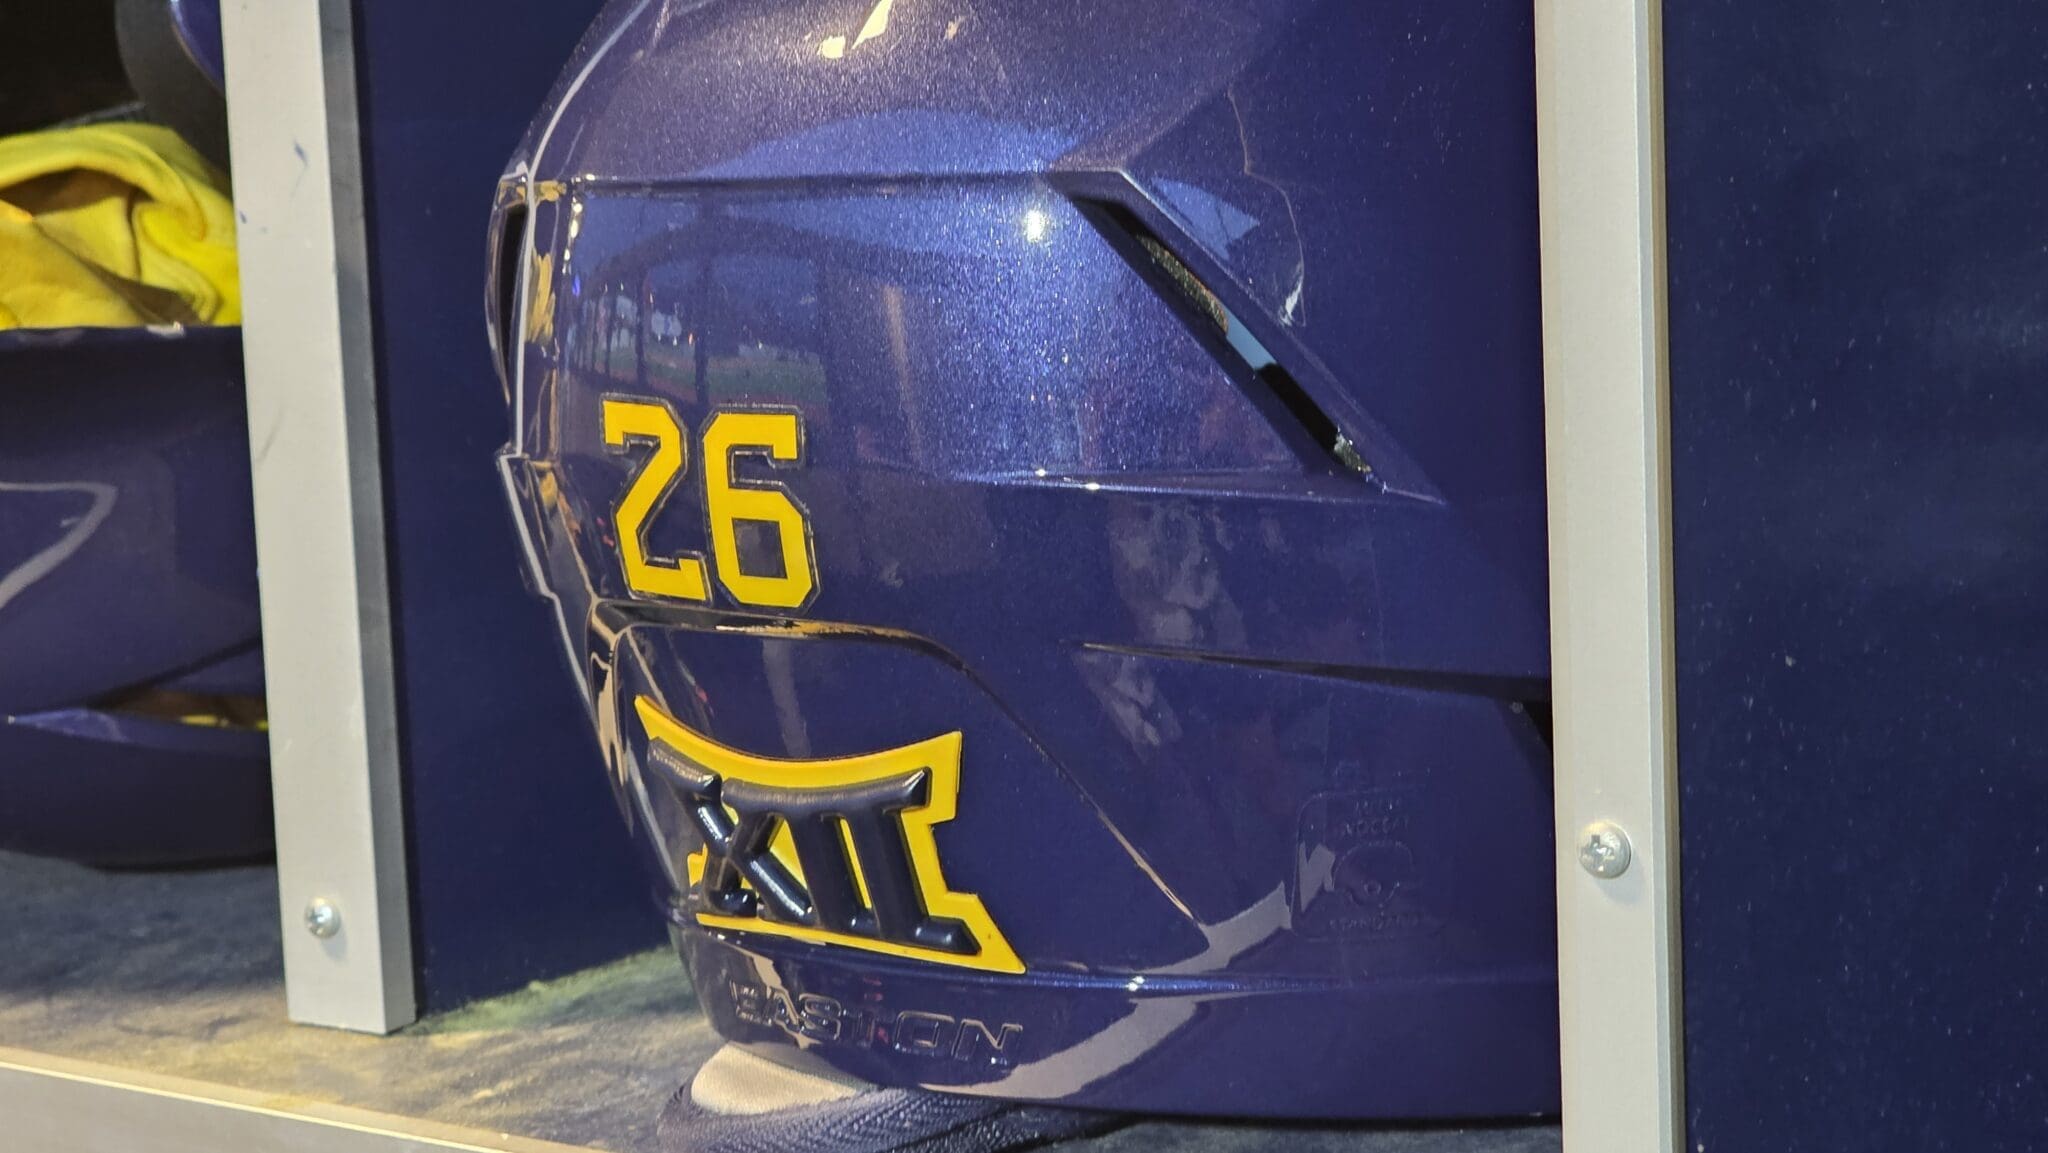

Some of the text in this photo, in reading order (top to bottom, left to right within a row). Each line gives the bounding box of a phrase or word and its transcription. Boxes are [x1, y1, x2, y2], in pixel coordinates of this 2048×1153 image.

[602, 397, 817, 608] 26
[646, 736, 983, 956] XII
[728, 979, 1023, 1067] EASTON
